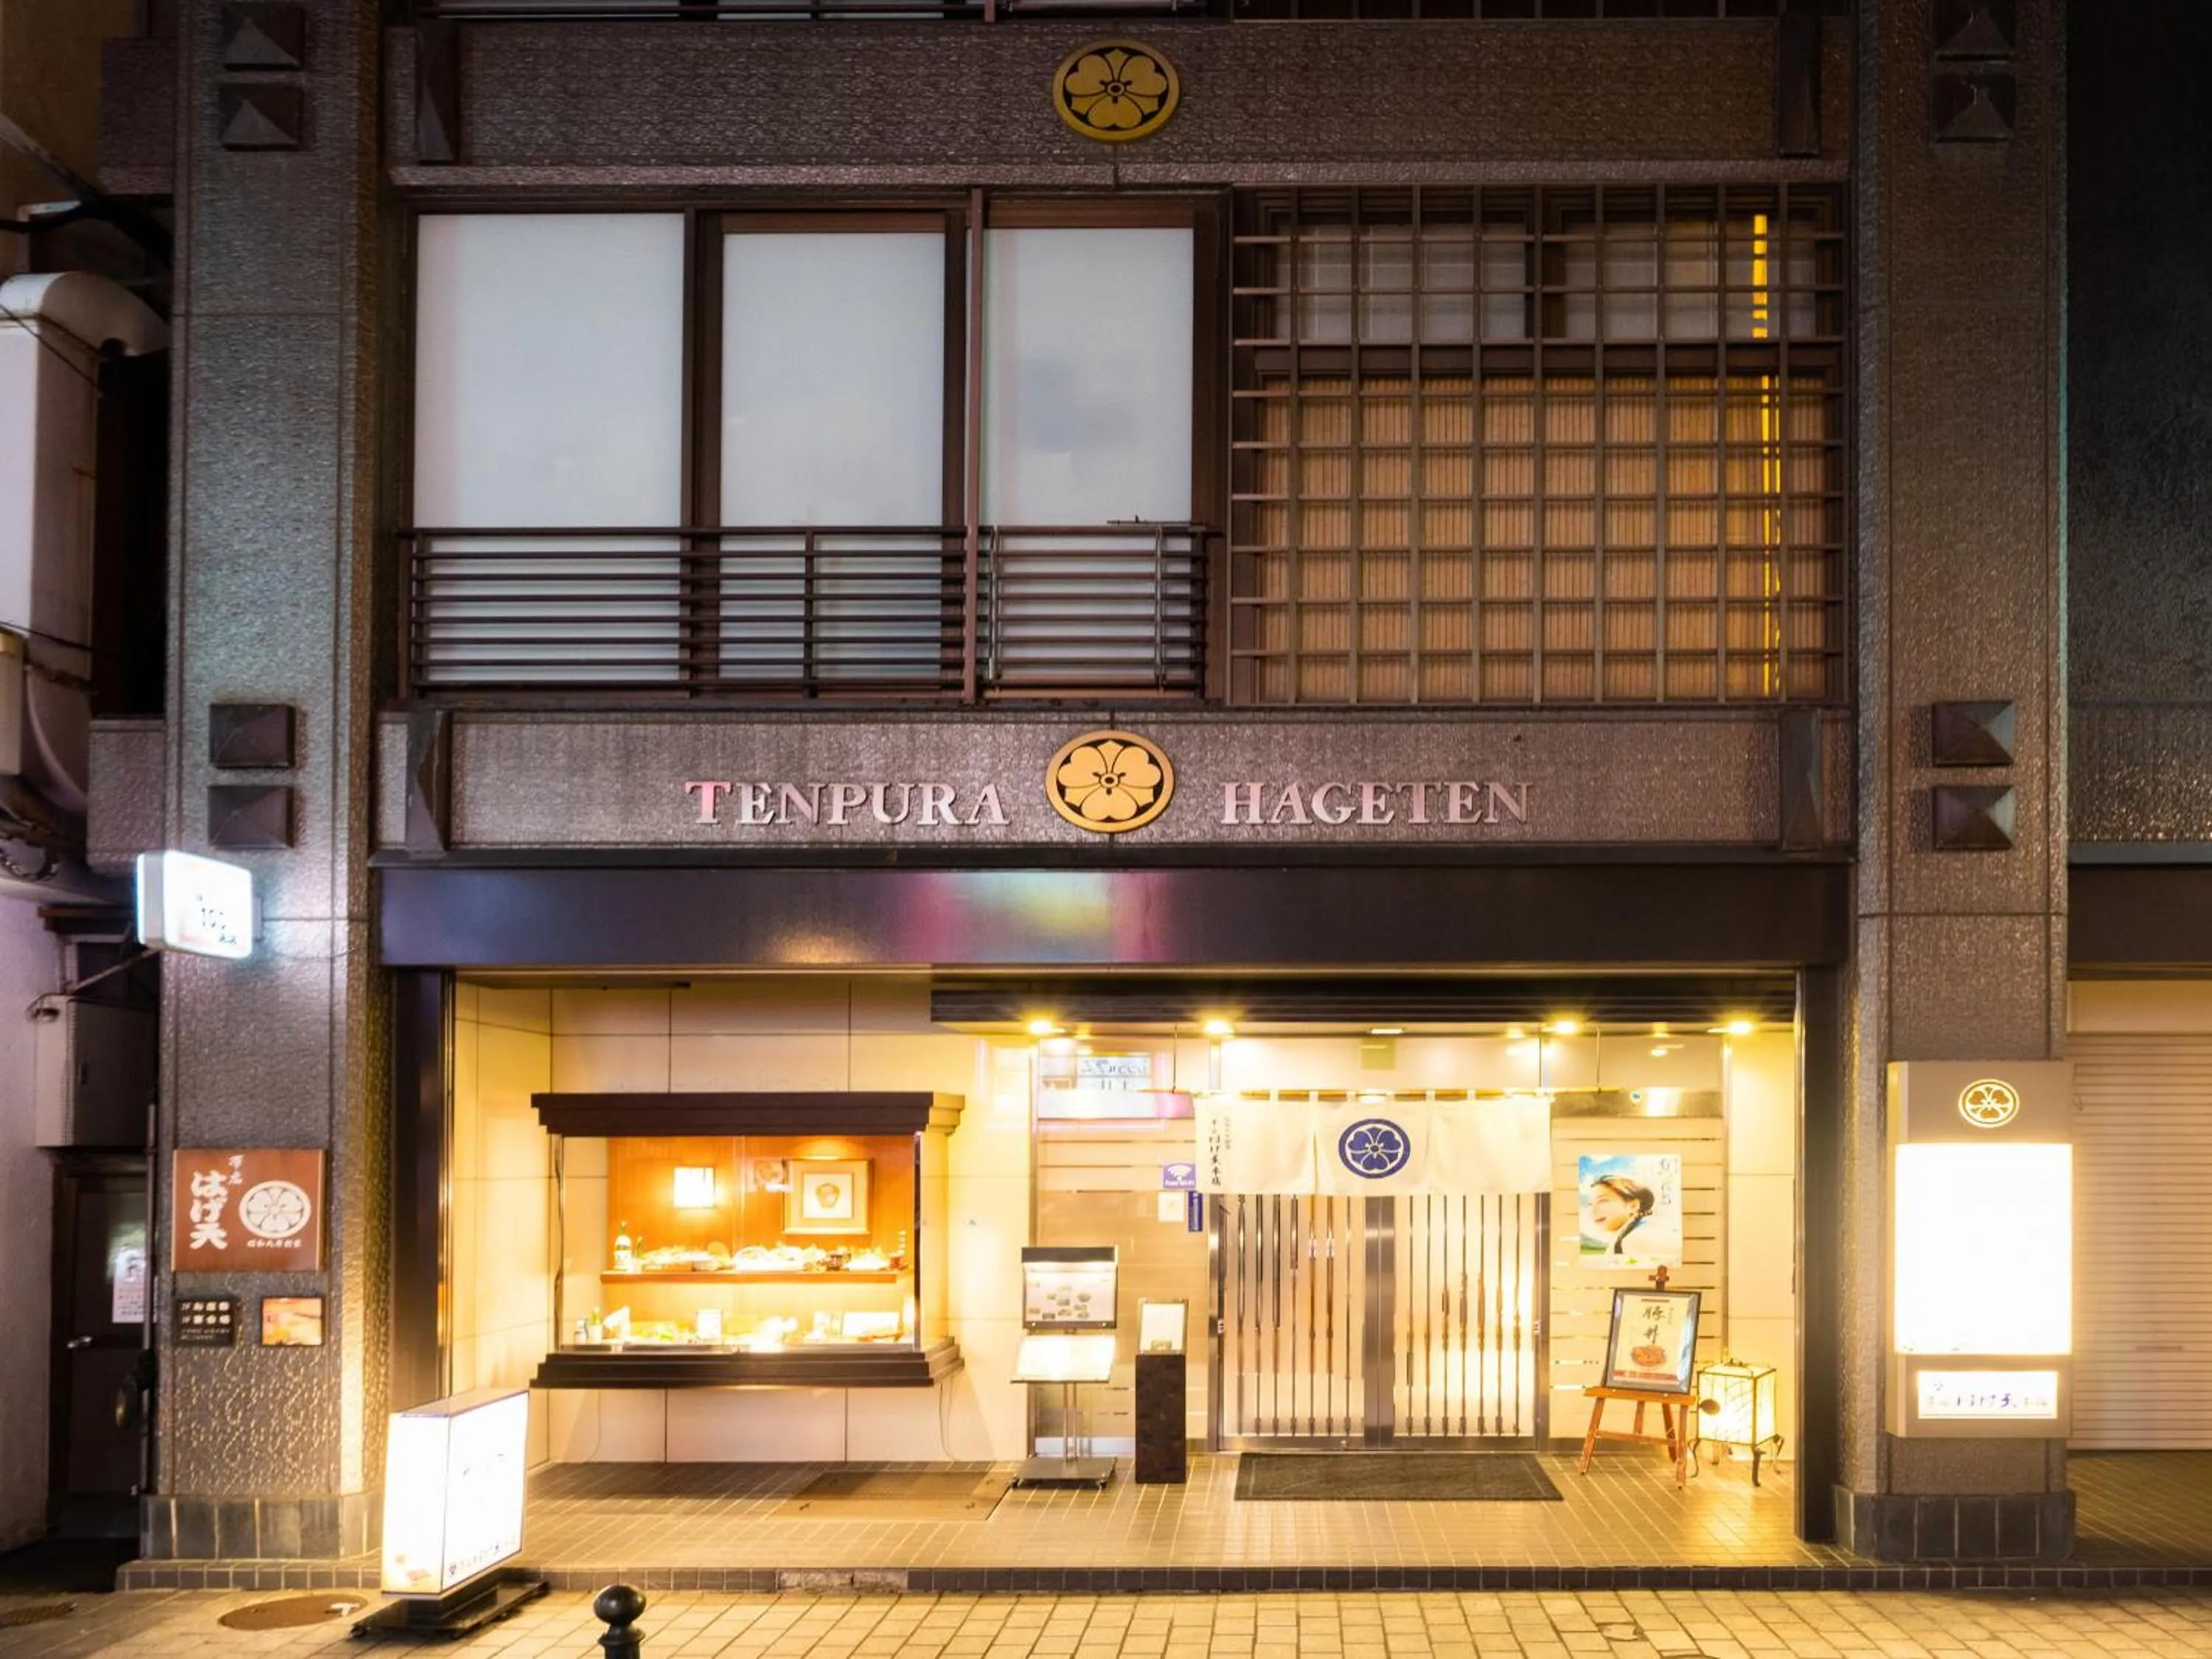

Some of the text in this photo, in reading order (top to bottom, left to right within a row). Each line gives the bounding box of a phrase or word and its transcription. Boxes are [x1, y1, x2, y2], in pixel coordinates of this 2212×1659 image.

[685, 781, 1530, 827] TENPURA HAGETEN
[189, 1169, 229, 1250] はげ天
